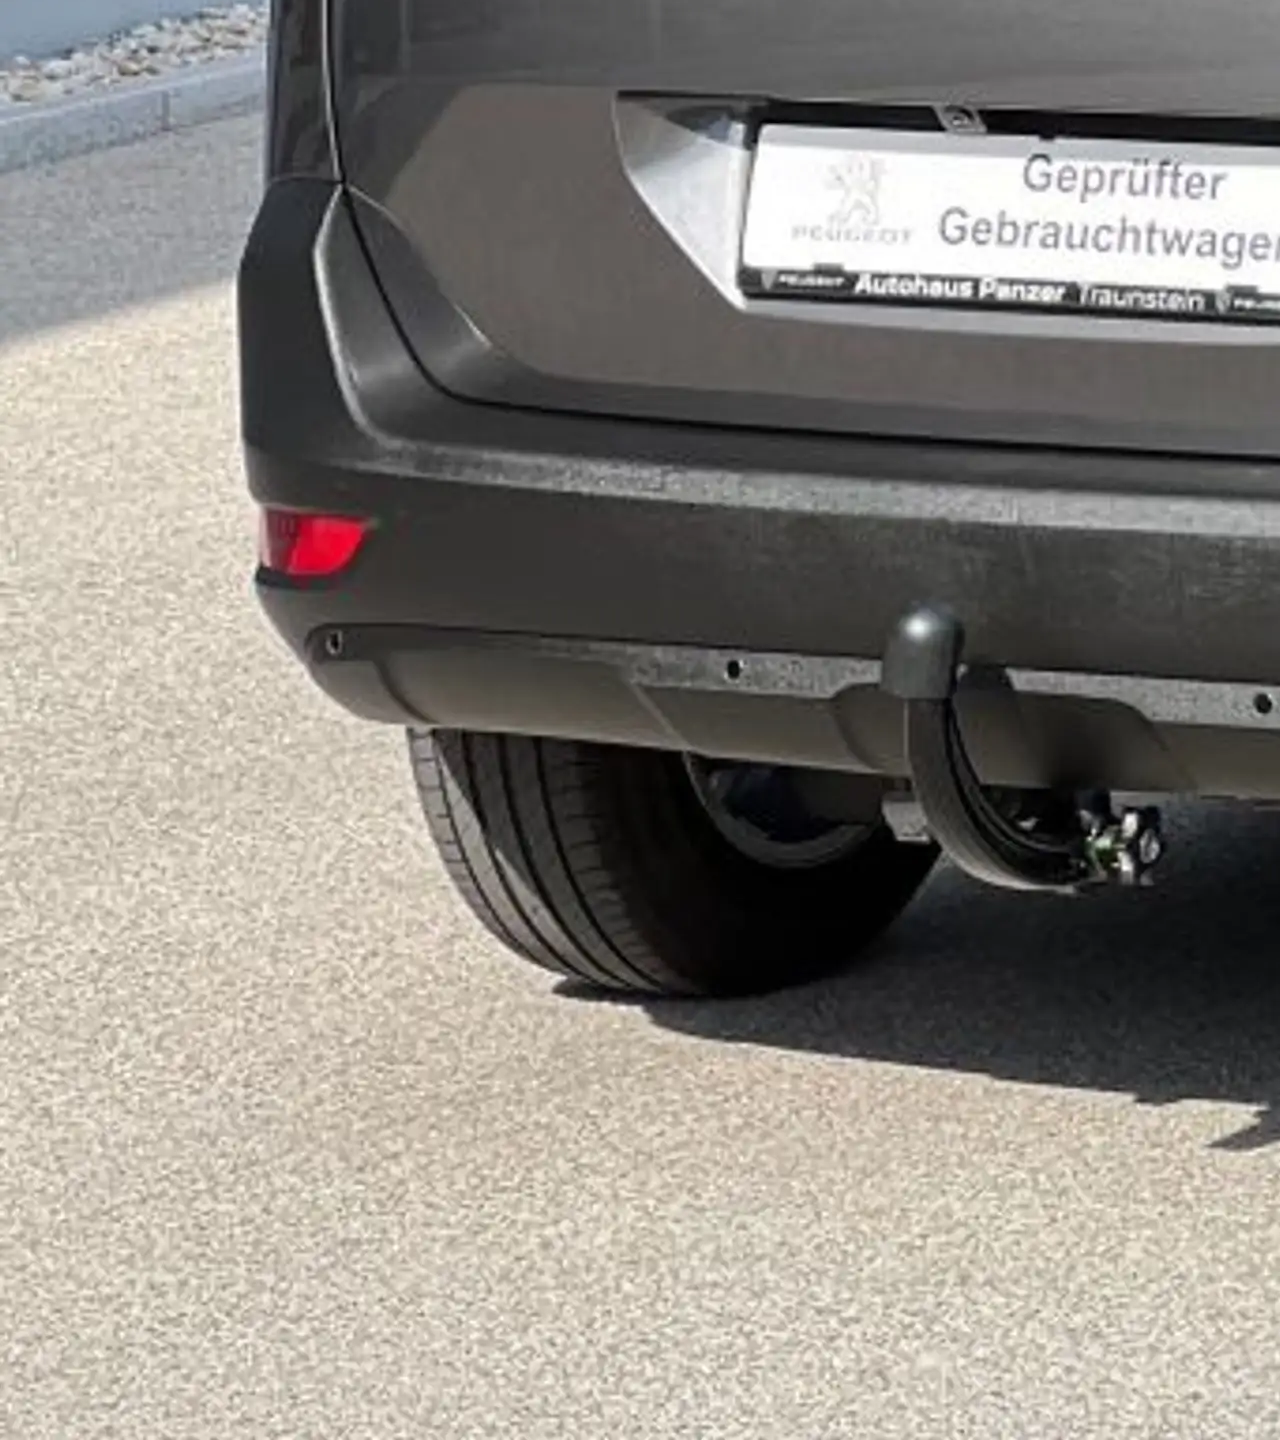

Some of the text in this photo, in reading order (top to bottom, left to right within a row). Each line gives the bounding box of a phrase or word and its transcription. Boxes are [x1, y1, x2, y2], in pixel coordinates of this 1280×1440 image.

[1022, 152, 1229, 204] Geprüfter
[854, 271, 1207, 312] Autohaus Panzer Traunstein
